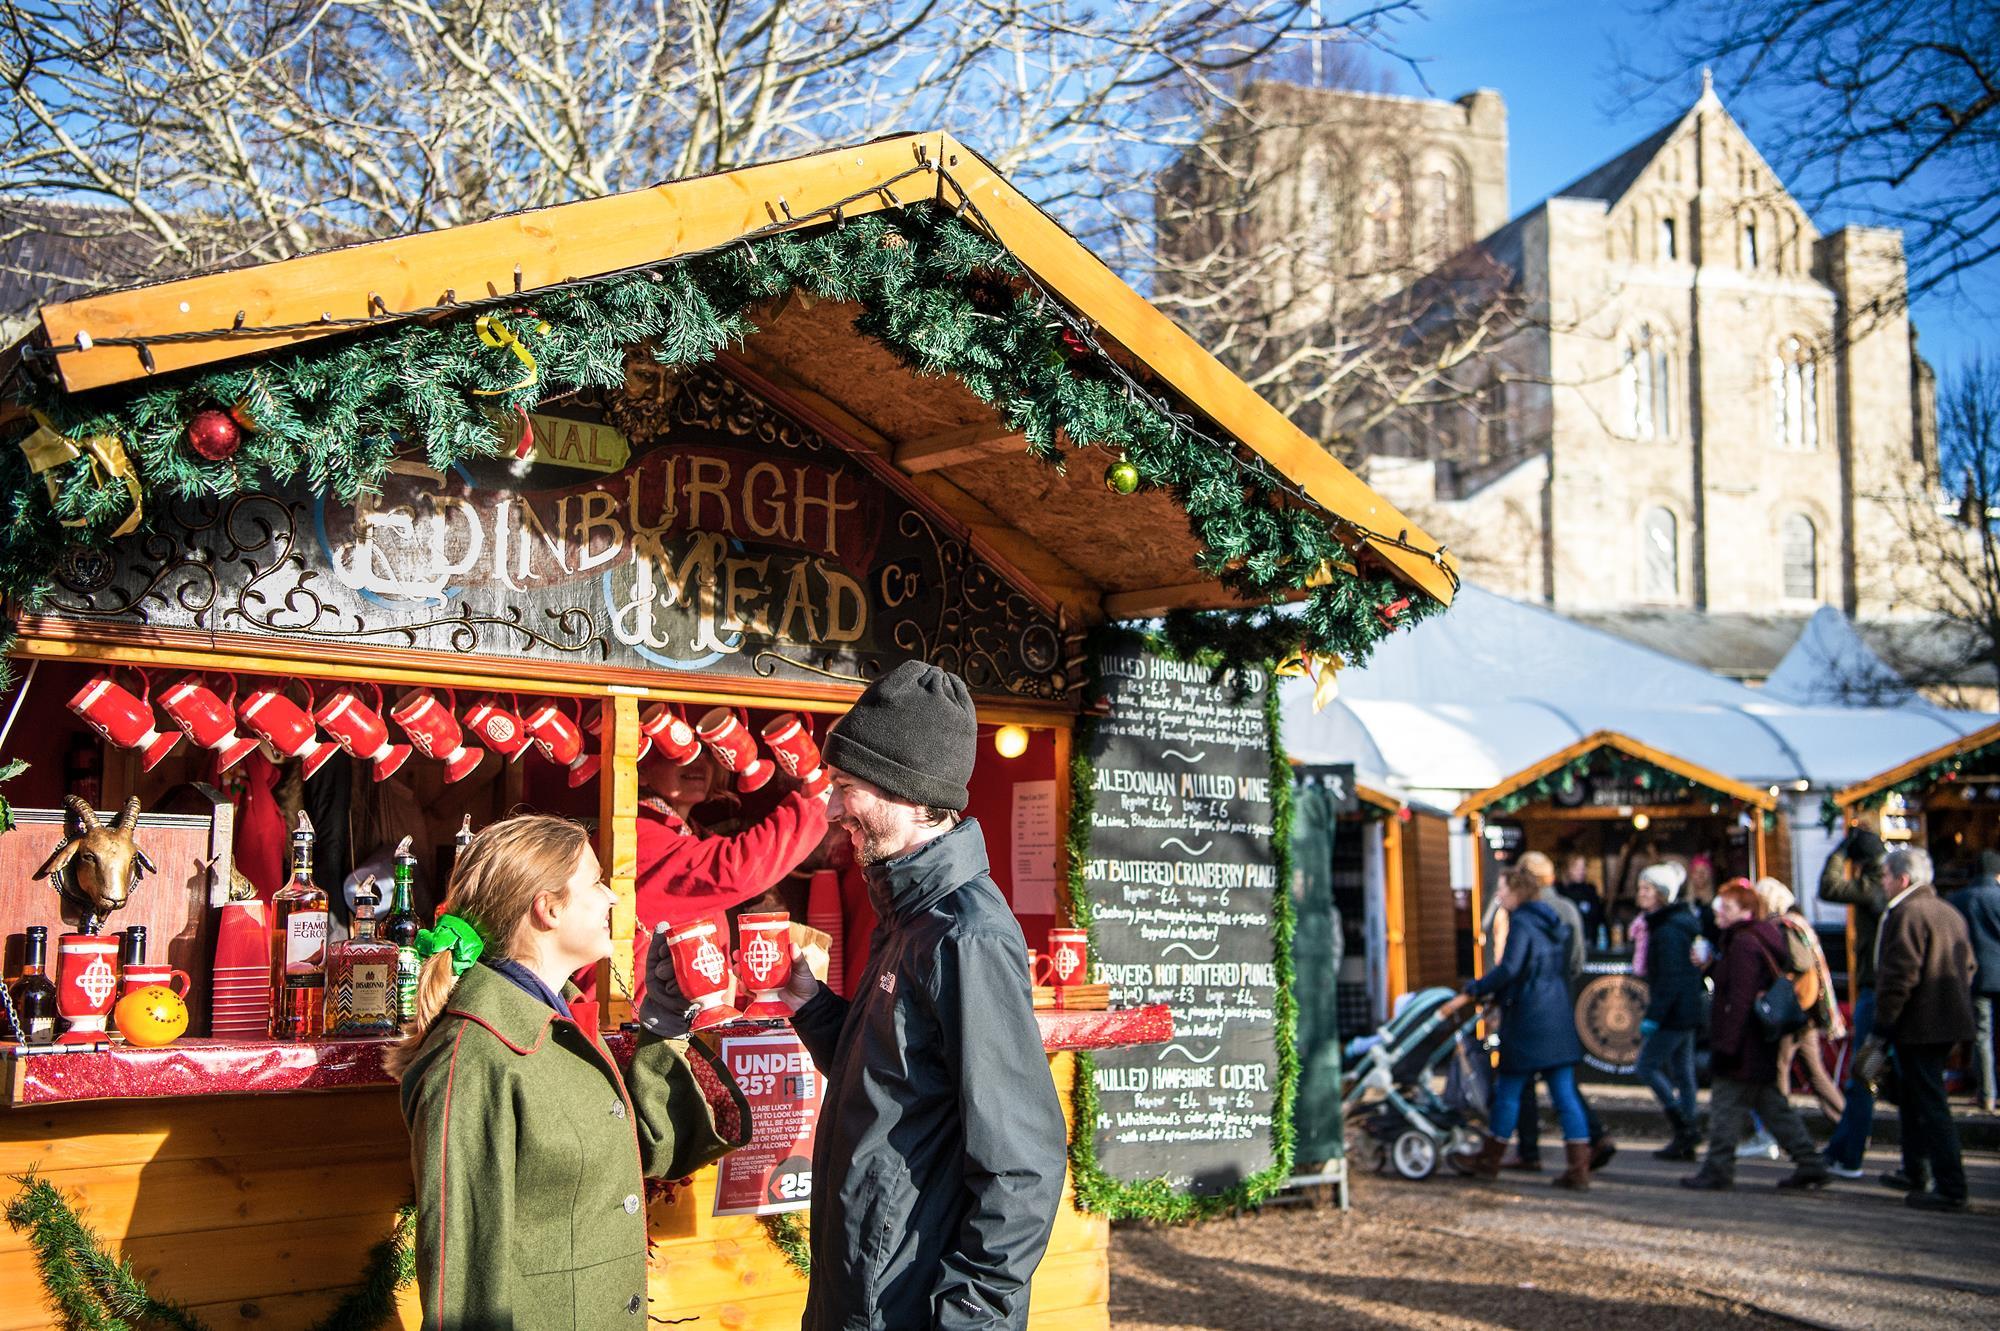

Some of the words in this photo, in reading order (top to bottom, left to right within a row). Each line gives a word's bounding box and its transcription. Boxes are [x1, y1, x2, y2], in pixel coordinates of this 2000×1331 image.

[333, 454, 858, 609] EDINBURGH
[612, 531, 869, 654] MEAD
[1150, 657, 1212, 685] HIGHLAND
[1127, 680, 1144, 695] Reg
[1118, 711, 1125, 719] a
[1126, 709, 1143, 721] shot
[1145, 712, 1156, 725] of
[1119, 726, 1126, 735] a
[1127, 723, 1145, 737] shot
[1147, 727, 1157, 740] of
[1181, 772, 1236, 800] MULLED
[1238, 776, 1271, 804] WINE
[1152, 797, 1173, 818] £4
[1091, 812, 1107, 828] Red
[1109, 859, 1174, 887] BUTTERED
[1174, 861, 1245, 889] CRANBERRY
[302, 920, 327, 930] FAMO
[1093, 962, 1153, 987] DRIVERS
[1155, 963, 1181, 986] HOT
[1181, 962, 1240, 987] BUTTERED
[355, 981, 385, 989] DISARONNO
[735, 1052, 816, 1075] UNDER
[735, 1074, 776, 1096] 25?
[1151, 1066, 1216, 1090] HAMPSHIRE
[1220, 1062, 1270, 1092] CIDER
[757, 1104, 771, 1112] ARE
[771, 1103, 793, 1112] LUCKY
[773, 1111, 792, 1119] LOOK
[774, 1118, 784, 1126] BE
[1116, 1111, 1182, 1127] Whitehead's
[760, 1134, 770, 1142] OR
[770, 1133, 789, 1141] OVER
[1139, 1132, 1147, 1142] a
[761, 1141, 793, 1150] ALCOHOL
